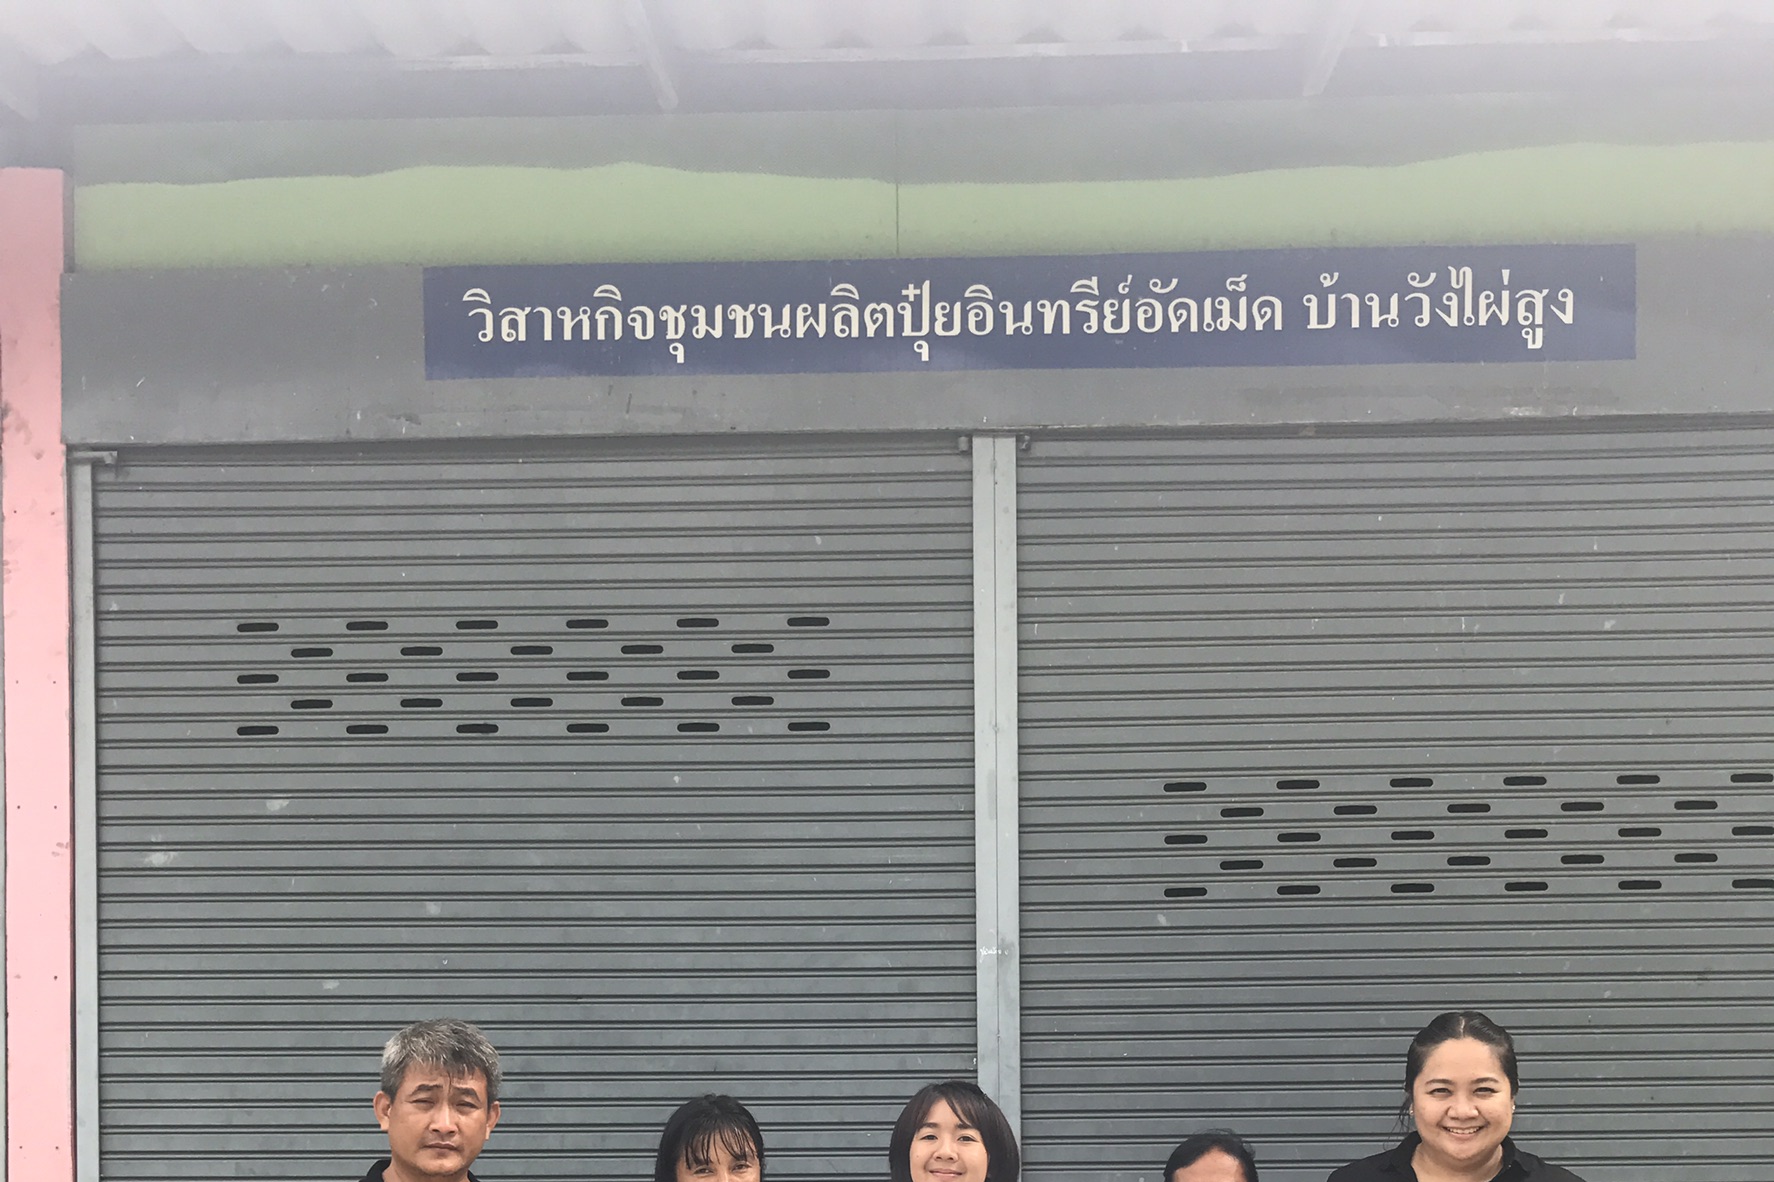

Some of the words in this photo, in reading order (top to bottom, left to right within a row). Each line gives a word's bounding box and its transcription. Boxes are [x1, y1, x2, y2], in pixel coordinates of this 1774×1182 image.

[462, 273, 1283, 364] วิสาหกิจชุมชนผลิตปุ๋ยอินทรีย์อัดเม็ด
[1302, 265, 1575, 350] บ้านวังไผ่สูง
